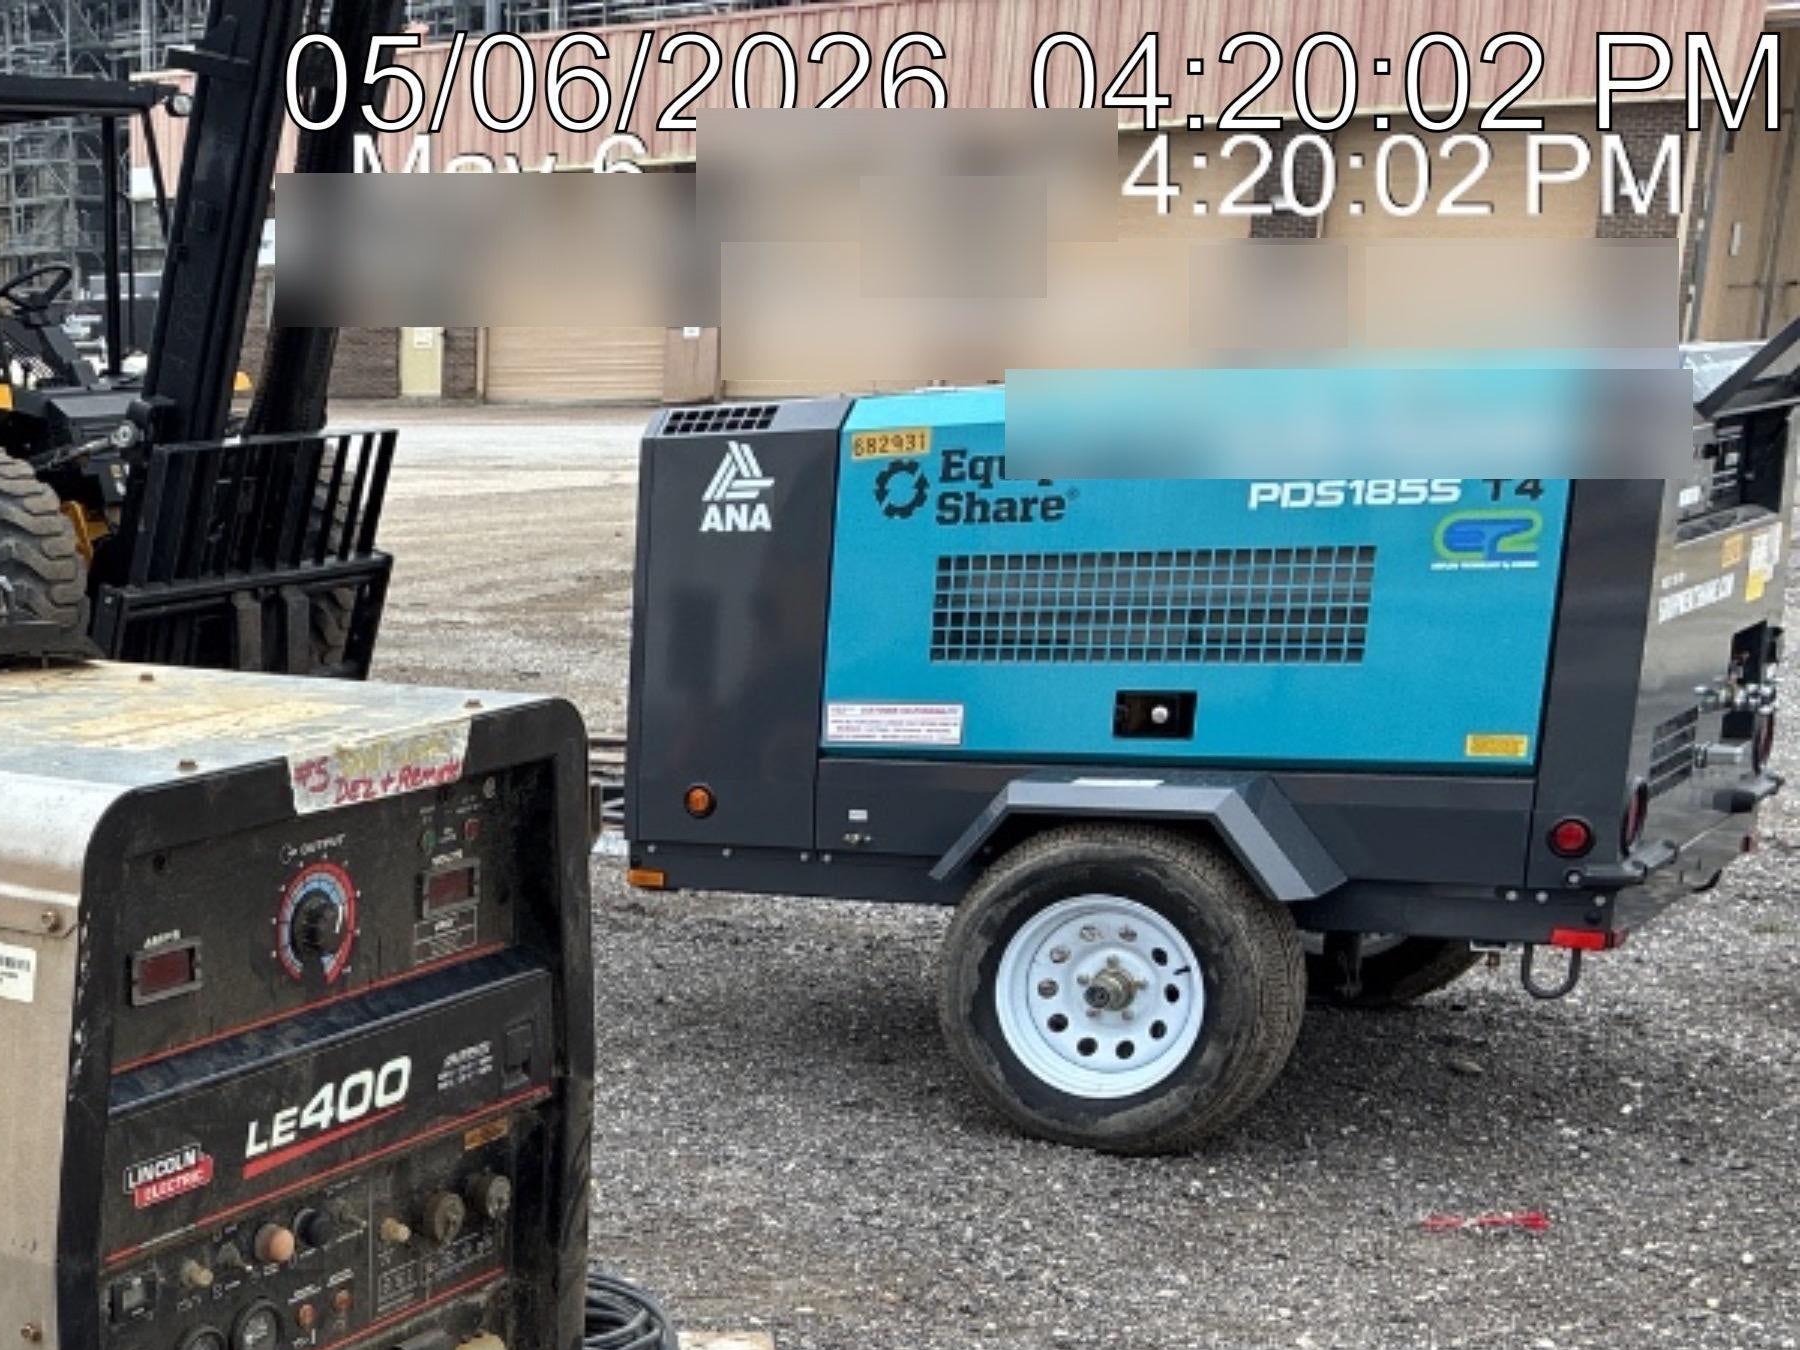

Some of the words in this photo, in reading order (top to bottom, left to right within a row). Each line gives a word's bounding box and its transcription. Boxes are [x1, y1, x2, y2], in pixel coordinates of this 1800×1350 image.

[699, 503, 772, 532] ANA
[936, 491, 1066, 526] Share
[245, 1055, 412, 1159] LE400
[128, 1148, 197, 1189] LINCOLN
